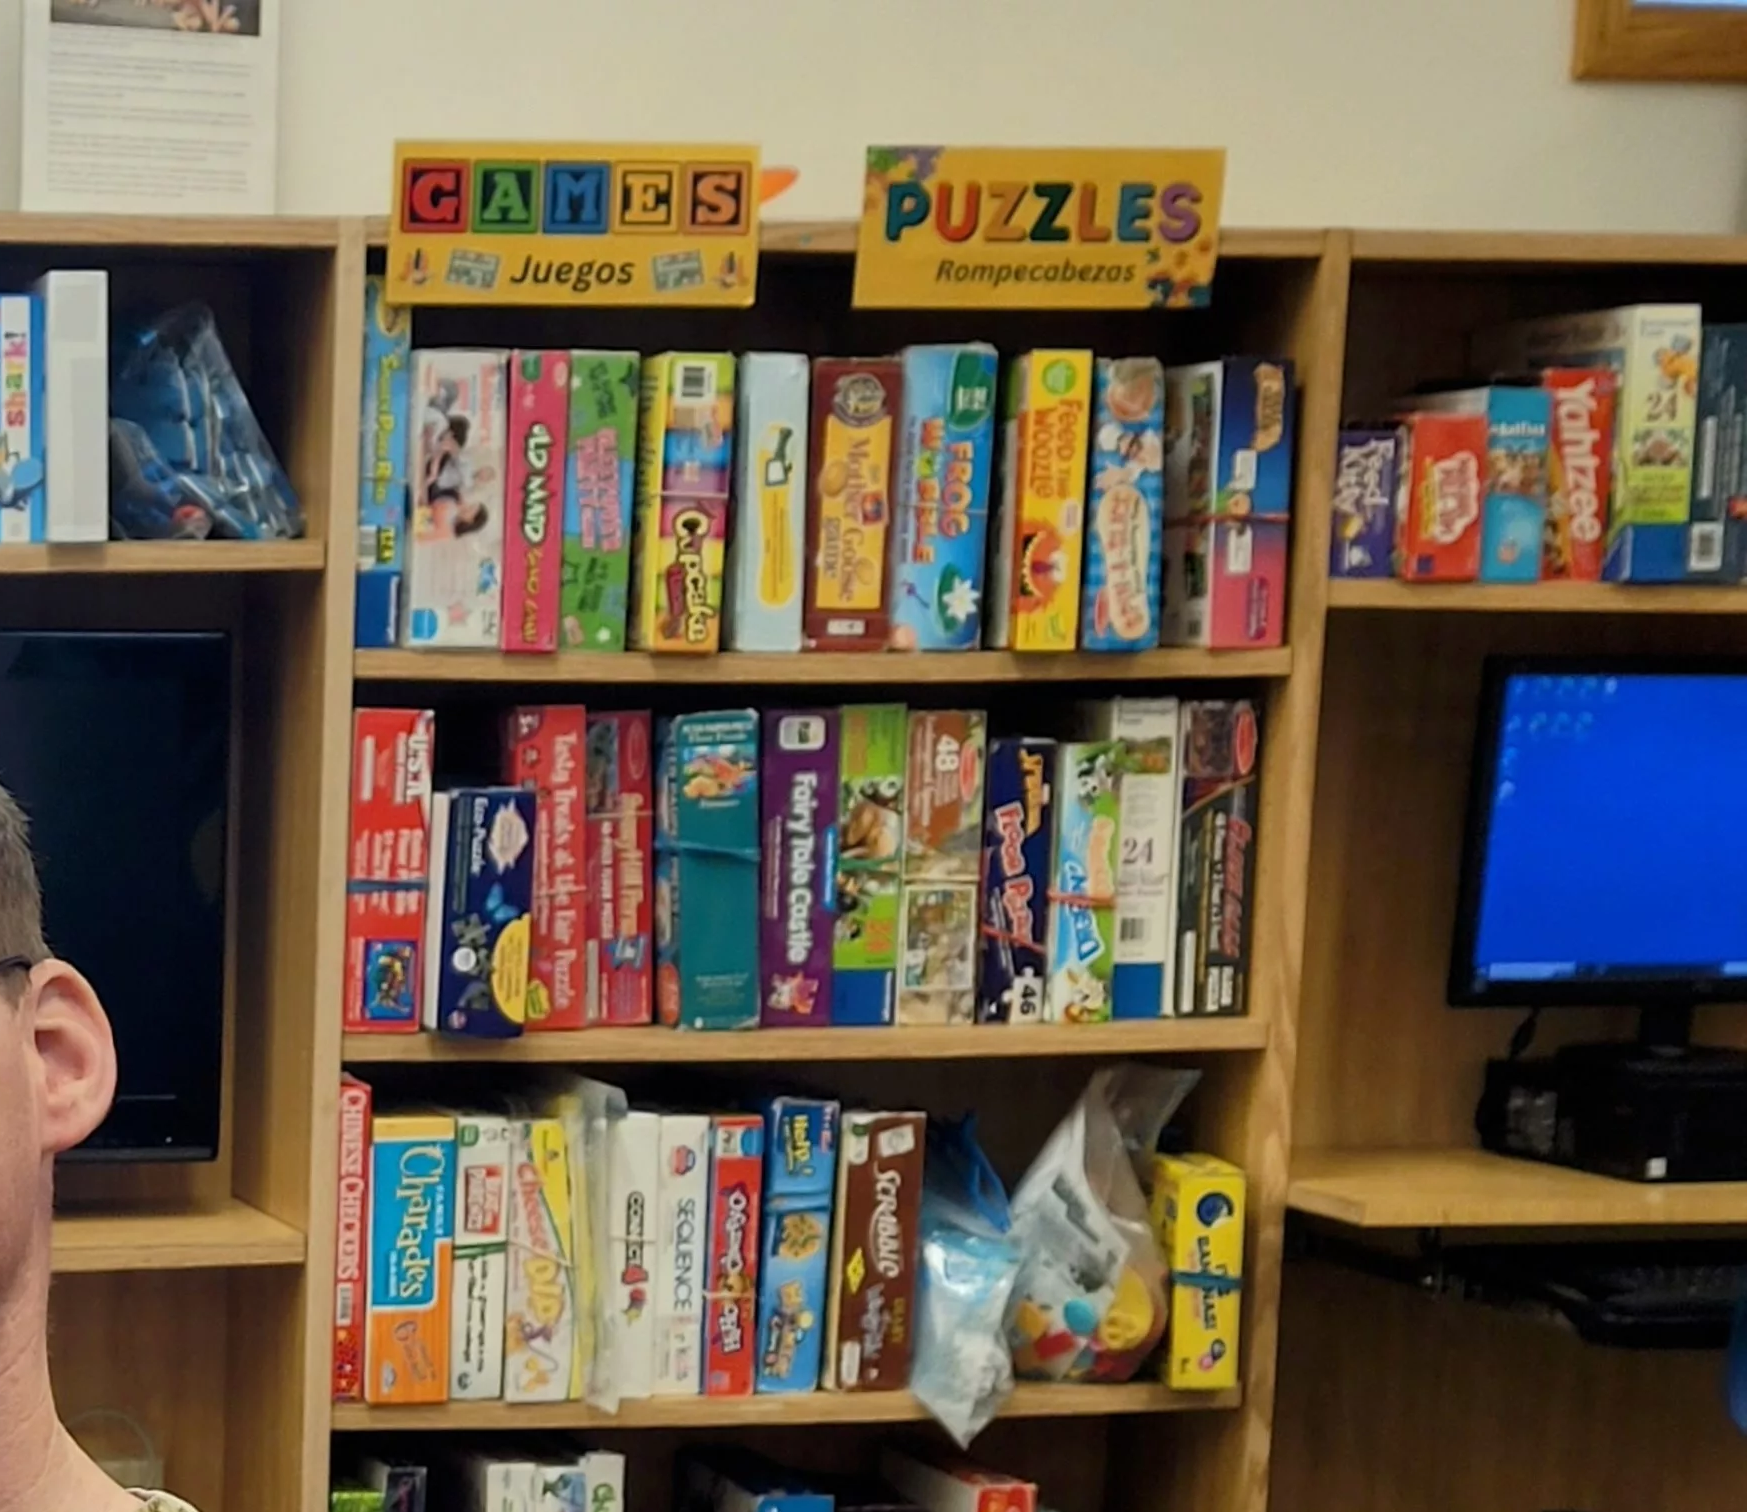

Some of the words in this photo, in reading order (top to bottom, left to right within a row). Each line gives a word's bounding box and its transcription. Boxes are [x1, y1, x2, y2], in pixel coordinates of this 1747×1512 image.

[405, 165, 747, 230] GAMES
[883, 180, 1203, 244] PUZZLES
[510, 254, 635, 294] Juegos
[934, 253, 1138, 287] Rompecabezas
[940, 442, 974, 538] FROG
[1556, 377, 1603, 543] Yahtzee
[673, 509, 716, 642] Cupcake
[838, 526, 866, 603] Goose
[552, 731, 575, 783] Tasty
[935, 735, 959, 773] 48
[554, 787, 577, 843] Treats
[786, 771, 817, 833] Fairy
[791, 836, 815, 884] Tale
[1120, 836, 1155, 866] 24
[786, 886, 811, 964] Castle
[341, 1088, 363, 1175] CHINESE
[339, 1177, 364, 1280] CHECKERS
[395, 1143, 444, 1298] Charades
[673, 1198, 696, 1312] SEQUENCE
